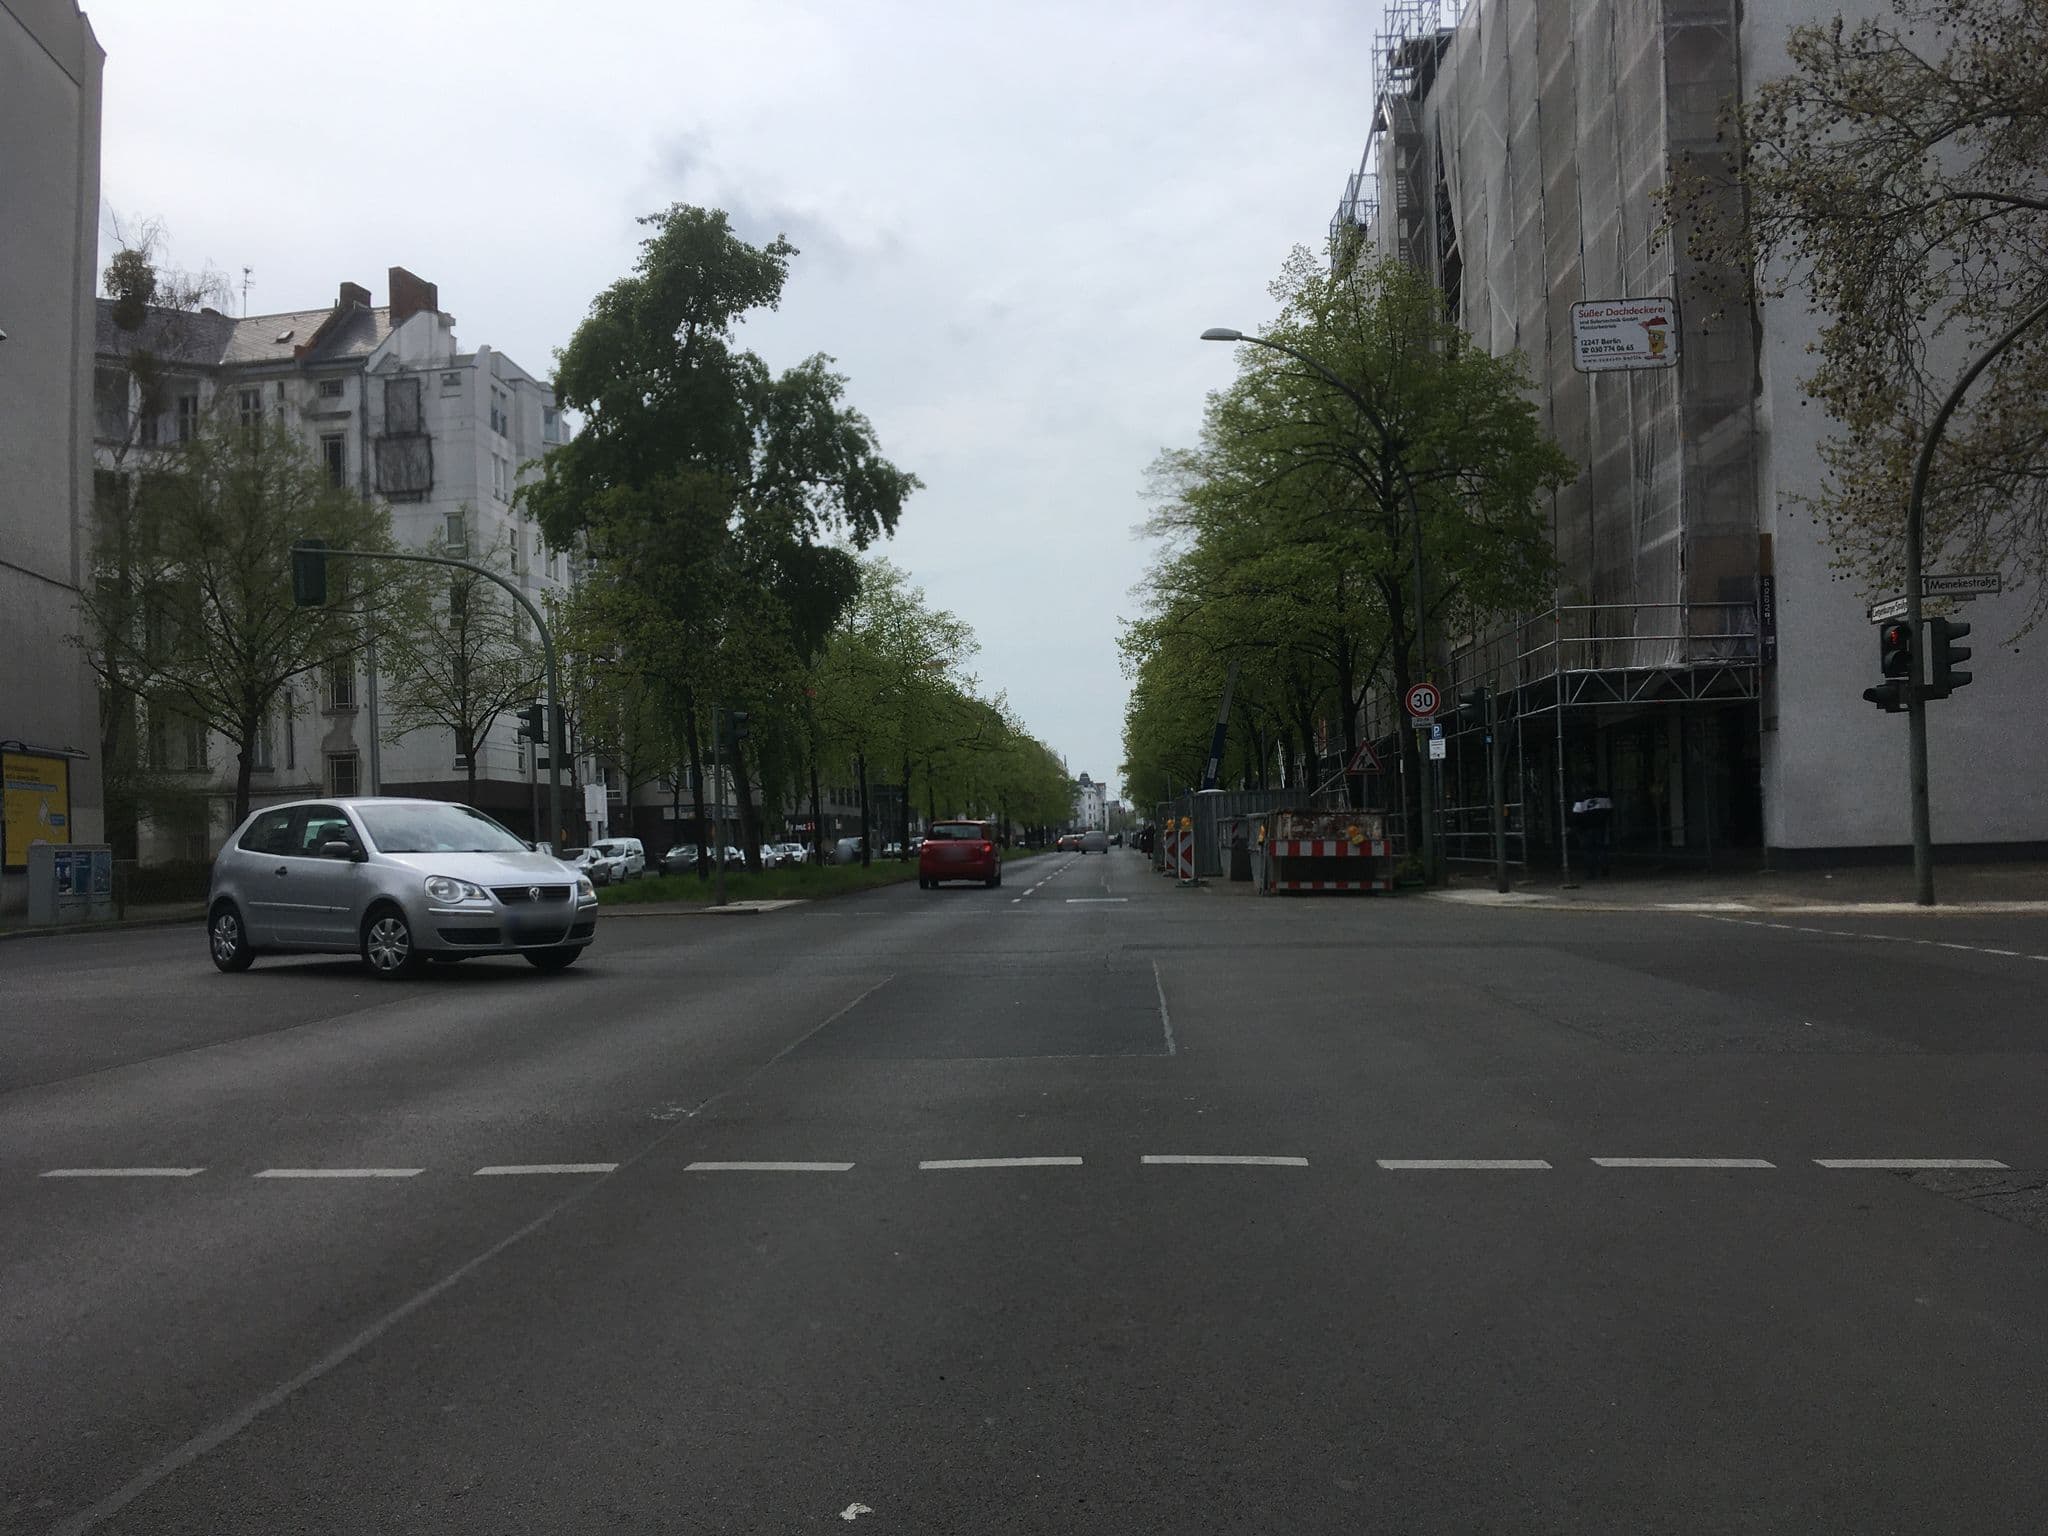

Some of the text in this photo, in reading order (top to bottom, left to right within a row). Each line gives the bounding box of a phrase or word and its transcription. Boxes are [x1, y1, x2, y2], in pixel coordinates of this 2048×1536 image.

[1606, 305, 1666, 316] Dachdeckerei
[1580, 337, 1622, 346] 12247 Berlin
[1930, 577, 1997, 590] Meinekestraße
[1413, 692, 1433, 708] 30
